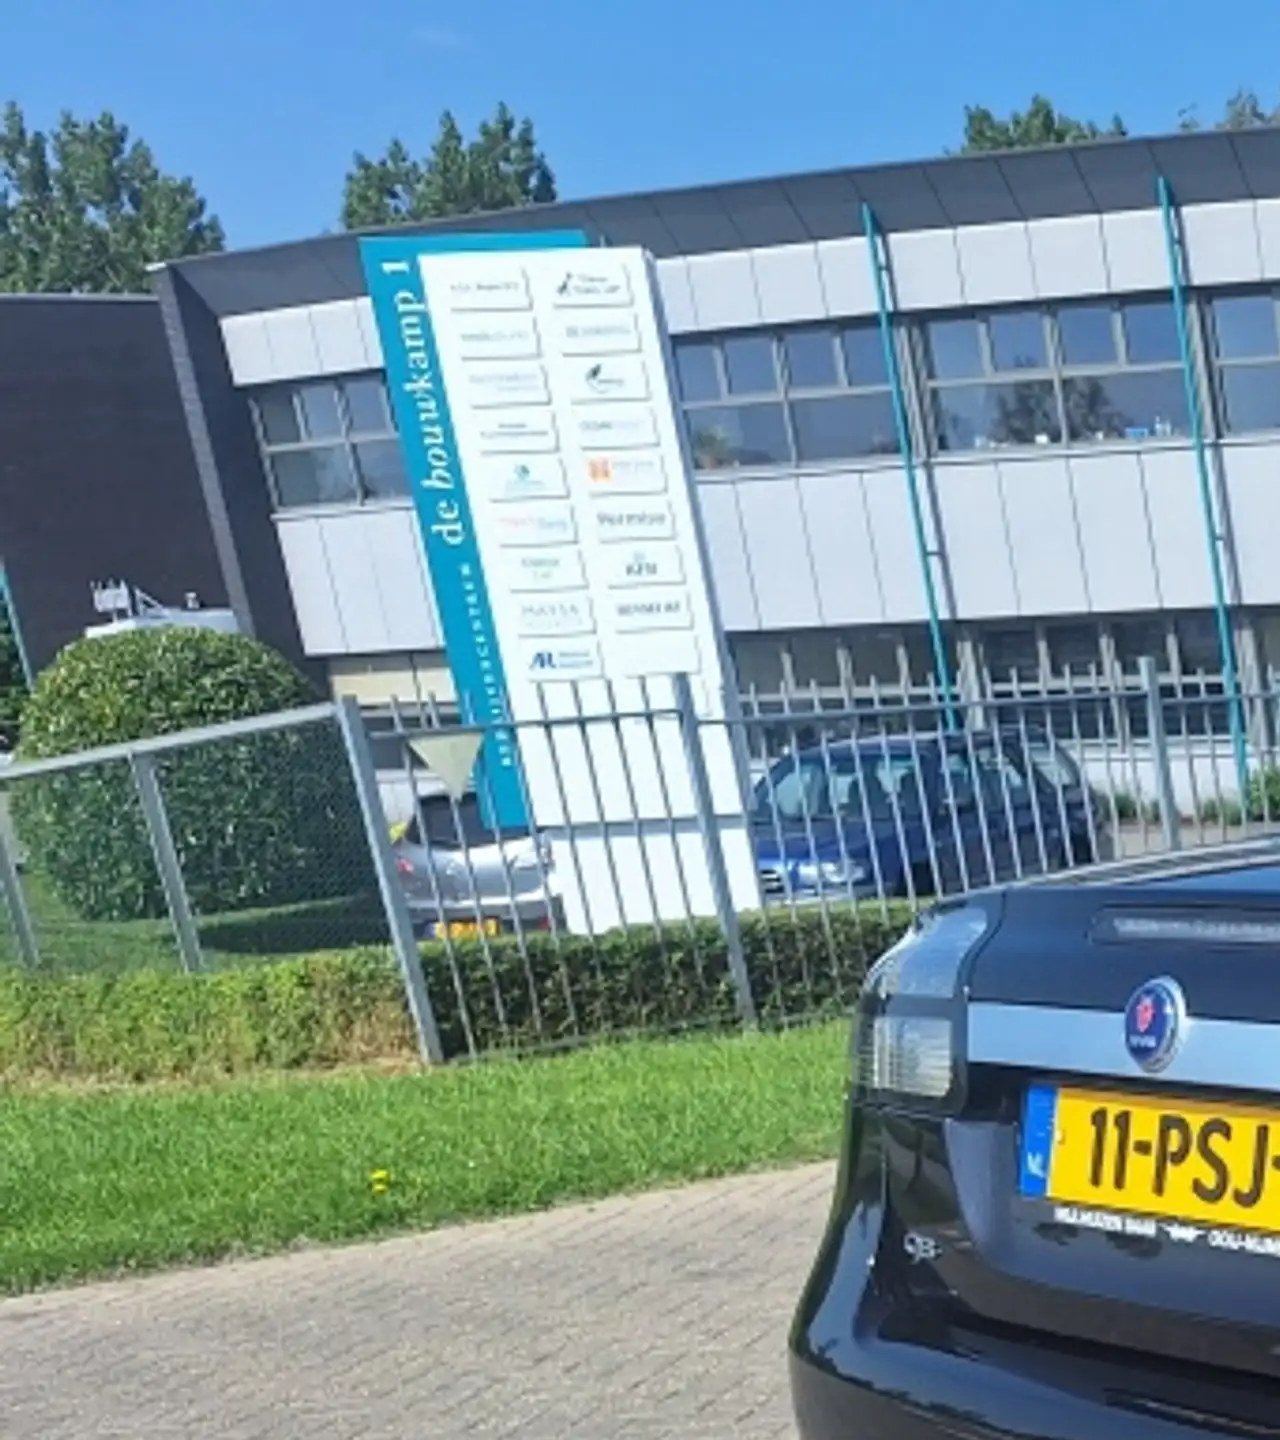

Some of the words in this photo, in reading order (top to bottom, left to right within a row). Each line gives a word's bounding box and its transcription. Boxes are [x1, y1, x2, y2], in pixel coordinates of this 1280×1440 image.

[381, 261, 410, 275] 1
[394, 290, 455, 489] bouwkamp
[430, 500, 466, 545] de
